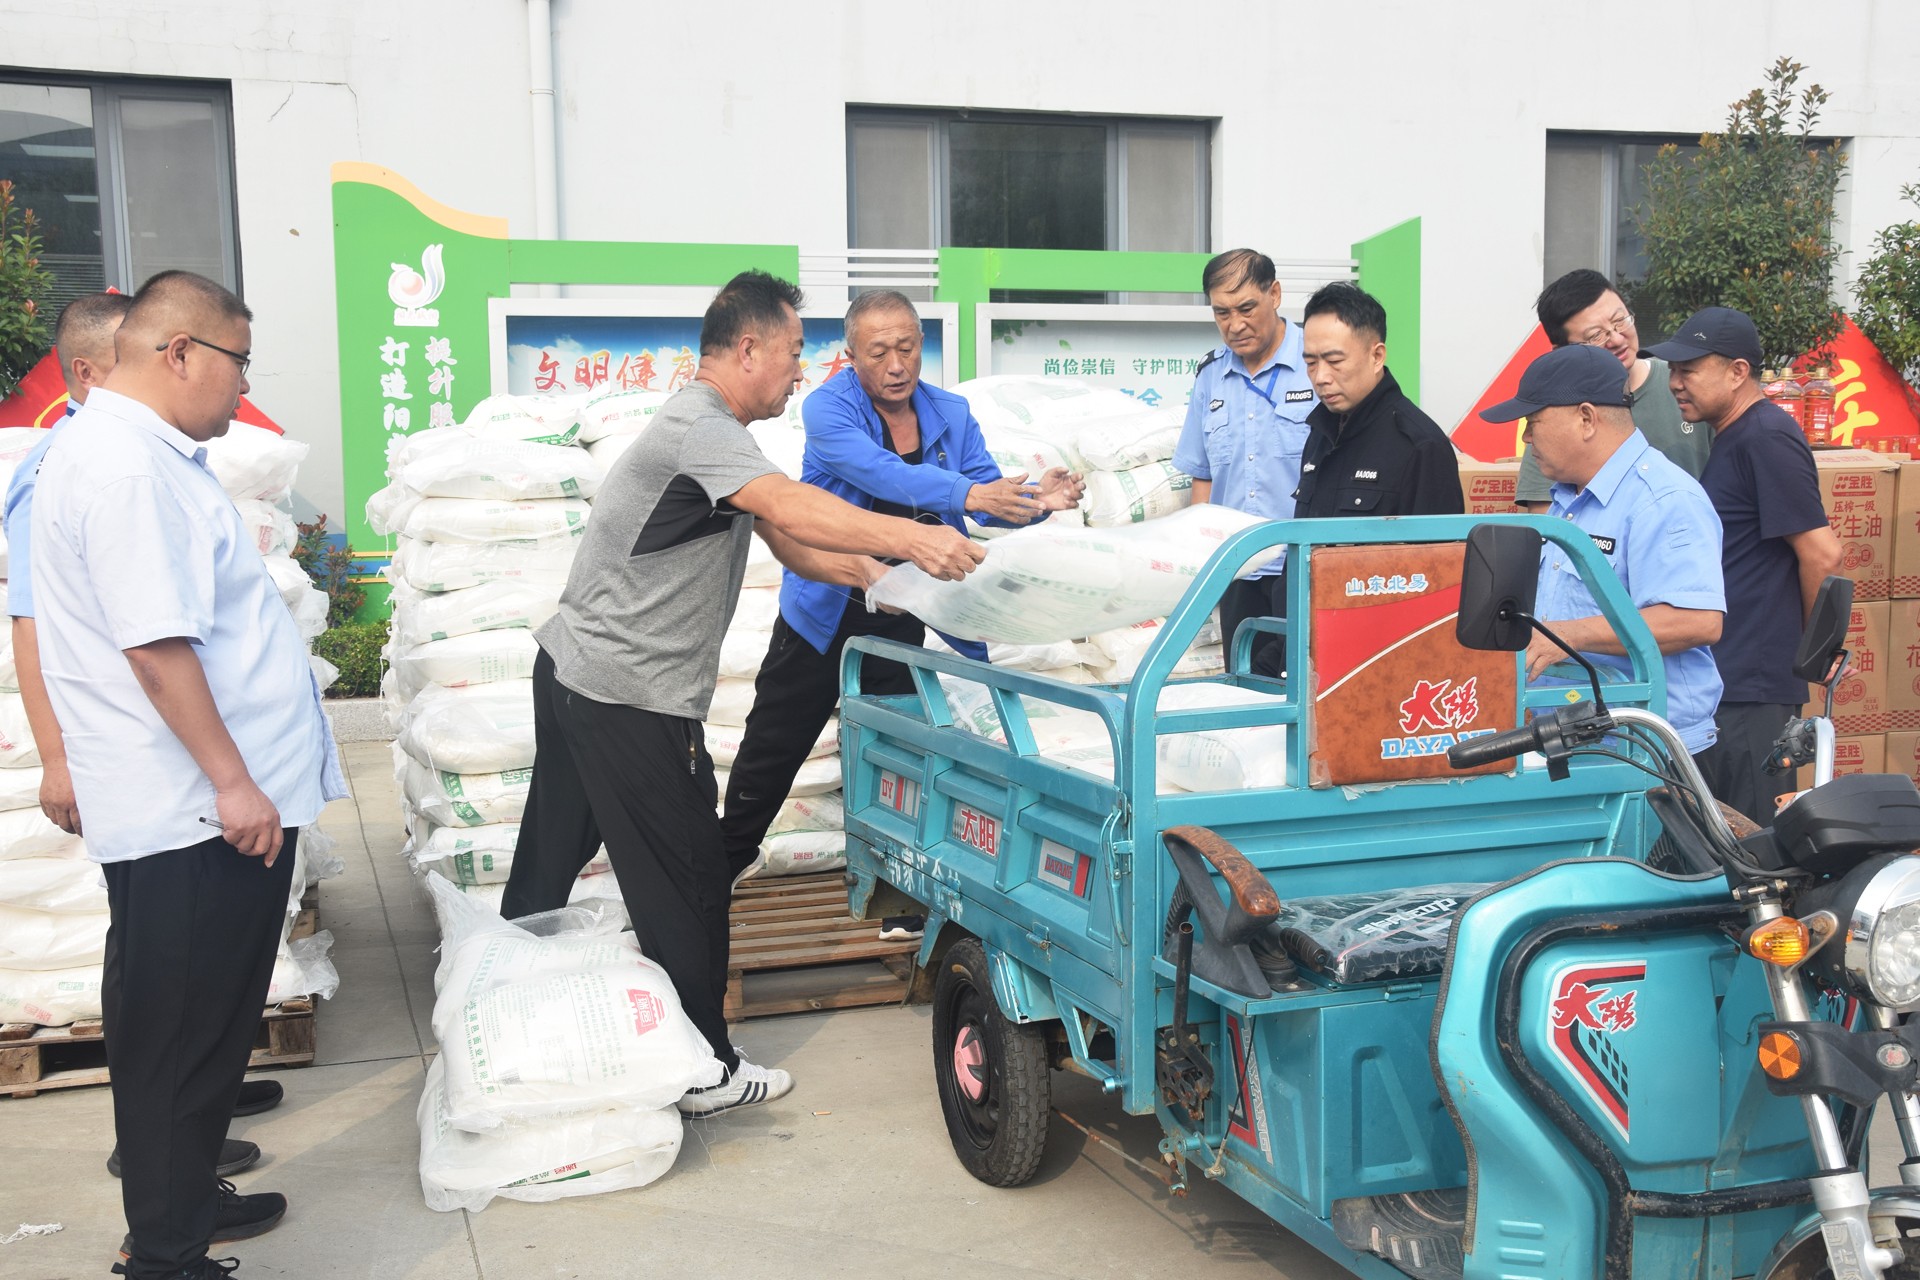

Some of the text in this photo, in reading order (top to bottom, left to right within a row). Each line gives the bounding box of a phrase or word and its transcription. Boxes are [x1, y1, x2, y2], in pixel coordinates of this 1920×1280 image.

[1044, 358, 1198, 376] 尚俭崇信 守护阳光
[1487, 479, 1516, 494] 金胜
[1848, 475, 1873, 489] 金胜
[1833, 500, 1876, 513] 压榨一级
[1849, 611, 1863, 625] 胜
[881, 778, 894, 800] DY
[960, 808, 997, 856] 大阳
[1044, 856, 1074, 880] DAYANG
